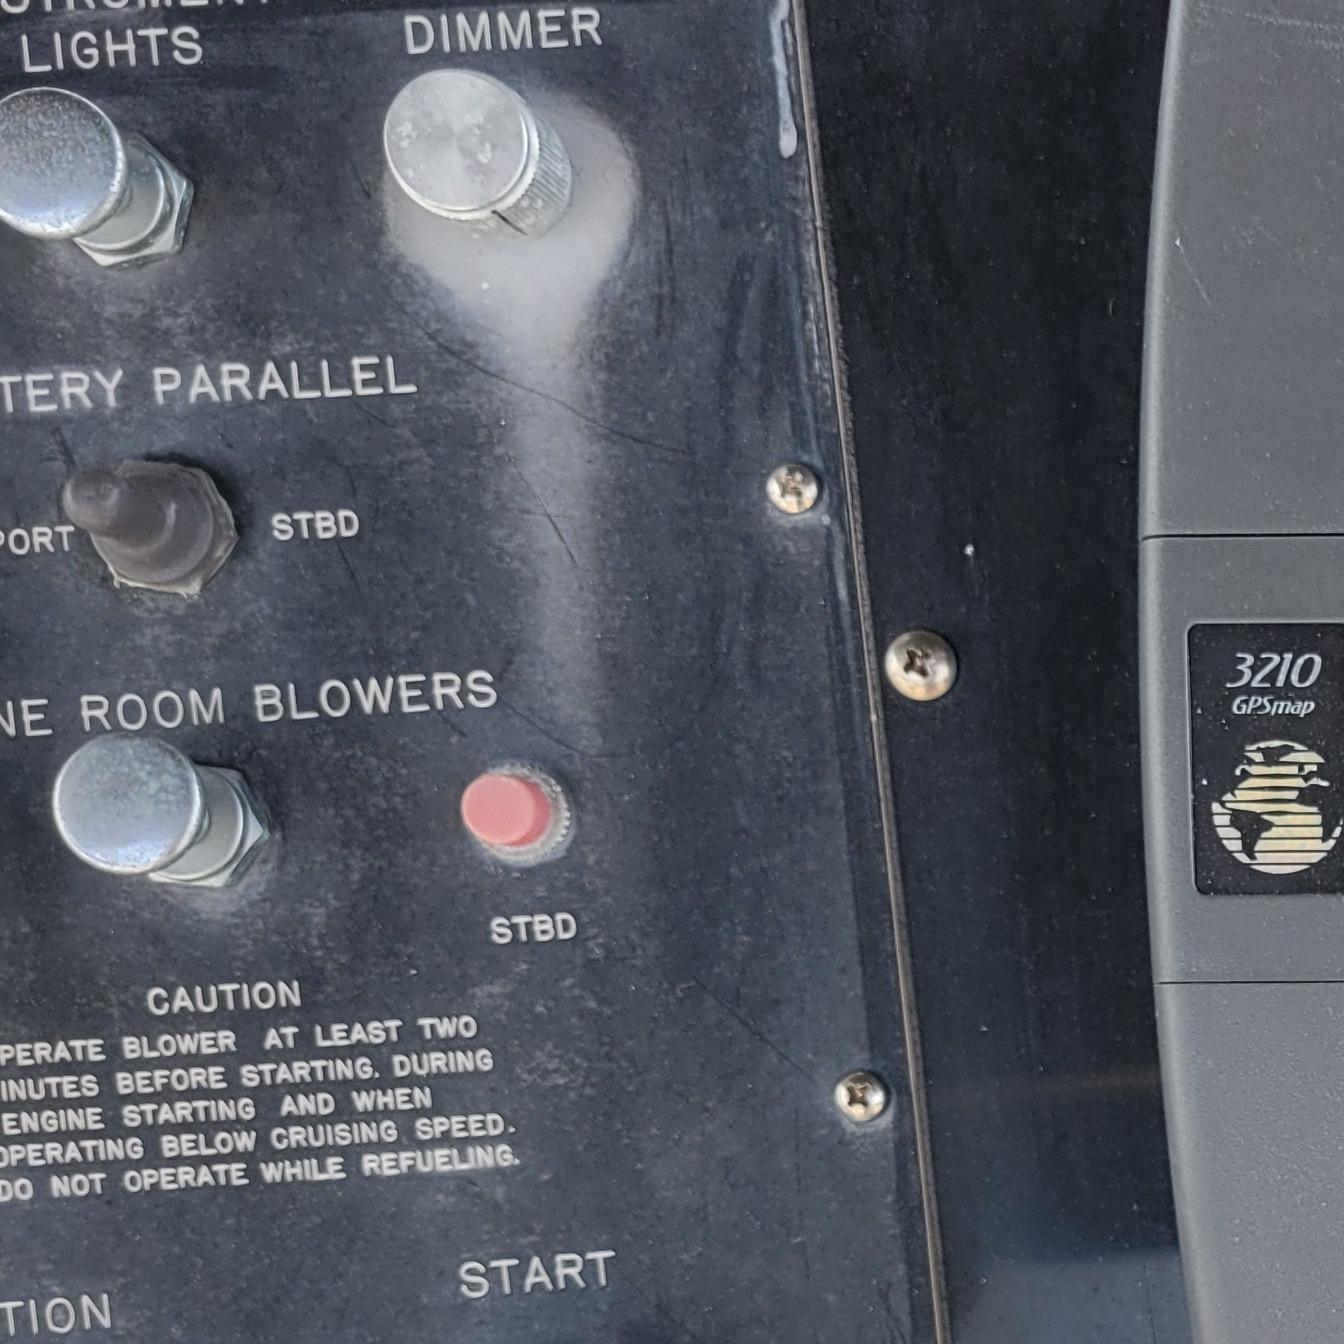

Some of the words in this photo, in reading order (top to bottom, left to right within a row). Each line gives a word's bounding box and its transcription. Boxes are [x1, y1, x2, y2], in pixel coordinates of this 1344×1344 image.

[21, 26, 203, 72] LIGHTS
[405, 6, 602, 55] DIMMER
[153, 355, 417, 404] PARALLEL
[271, 509, 360, 541] STBD
[1225, 652, 1323, 688] 3210
[80, 687, 225, 732] ROOM
[254, 669, 499, 723] BLOWERS
[1231, 695, 1316, 718] GPSmap
[489, 912, 578, 944] STBD
[147, 980, 301, 1017] CAUTION
[122, 1030, 237, 1059] BLOWER
[263, 1026, 299, 1050] AT
[314, 1019, 403, 1047] LEAST
[416, 1015, 478, 1040] TWO
[115, 1066, 228, 1095] BEFORE
[240, 1056, 380, 1087] STARTING.
[391, 1048, 495, 1078] DURING
[1, 1107, 105, 1135] ENGINE
[122, 1097, 256, 1128] STARTING
[281, 1092, 336, 1116] AND
[351, 1086, 433, 1113] WHEN
[160, 1130, 257, 1158] BELOW
[270, 1120, 399, 1150] CRUISING
[414, 1113, 517, 1141] SPEED.
[0, 1178, 33, 1201] DO
[50, 1173, 107, 1198] NOT
[123, 1163, 250, 1192] OPERATE
[260, 1156, 347, 1183] WHILE
[361, 1144, 521, 1177] REFUELING.
[459, 1249, 616, 1300] START
